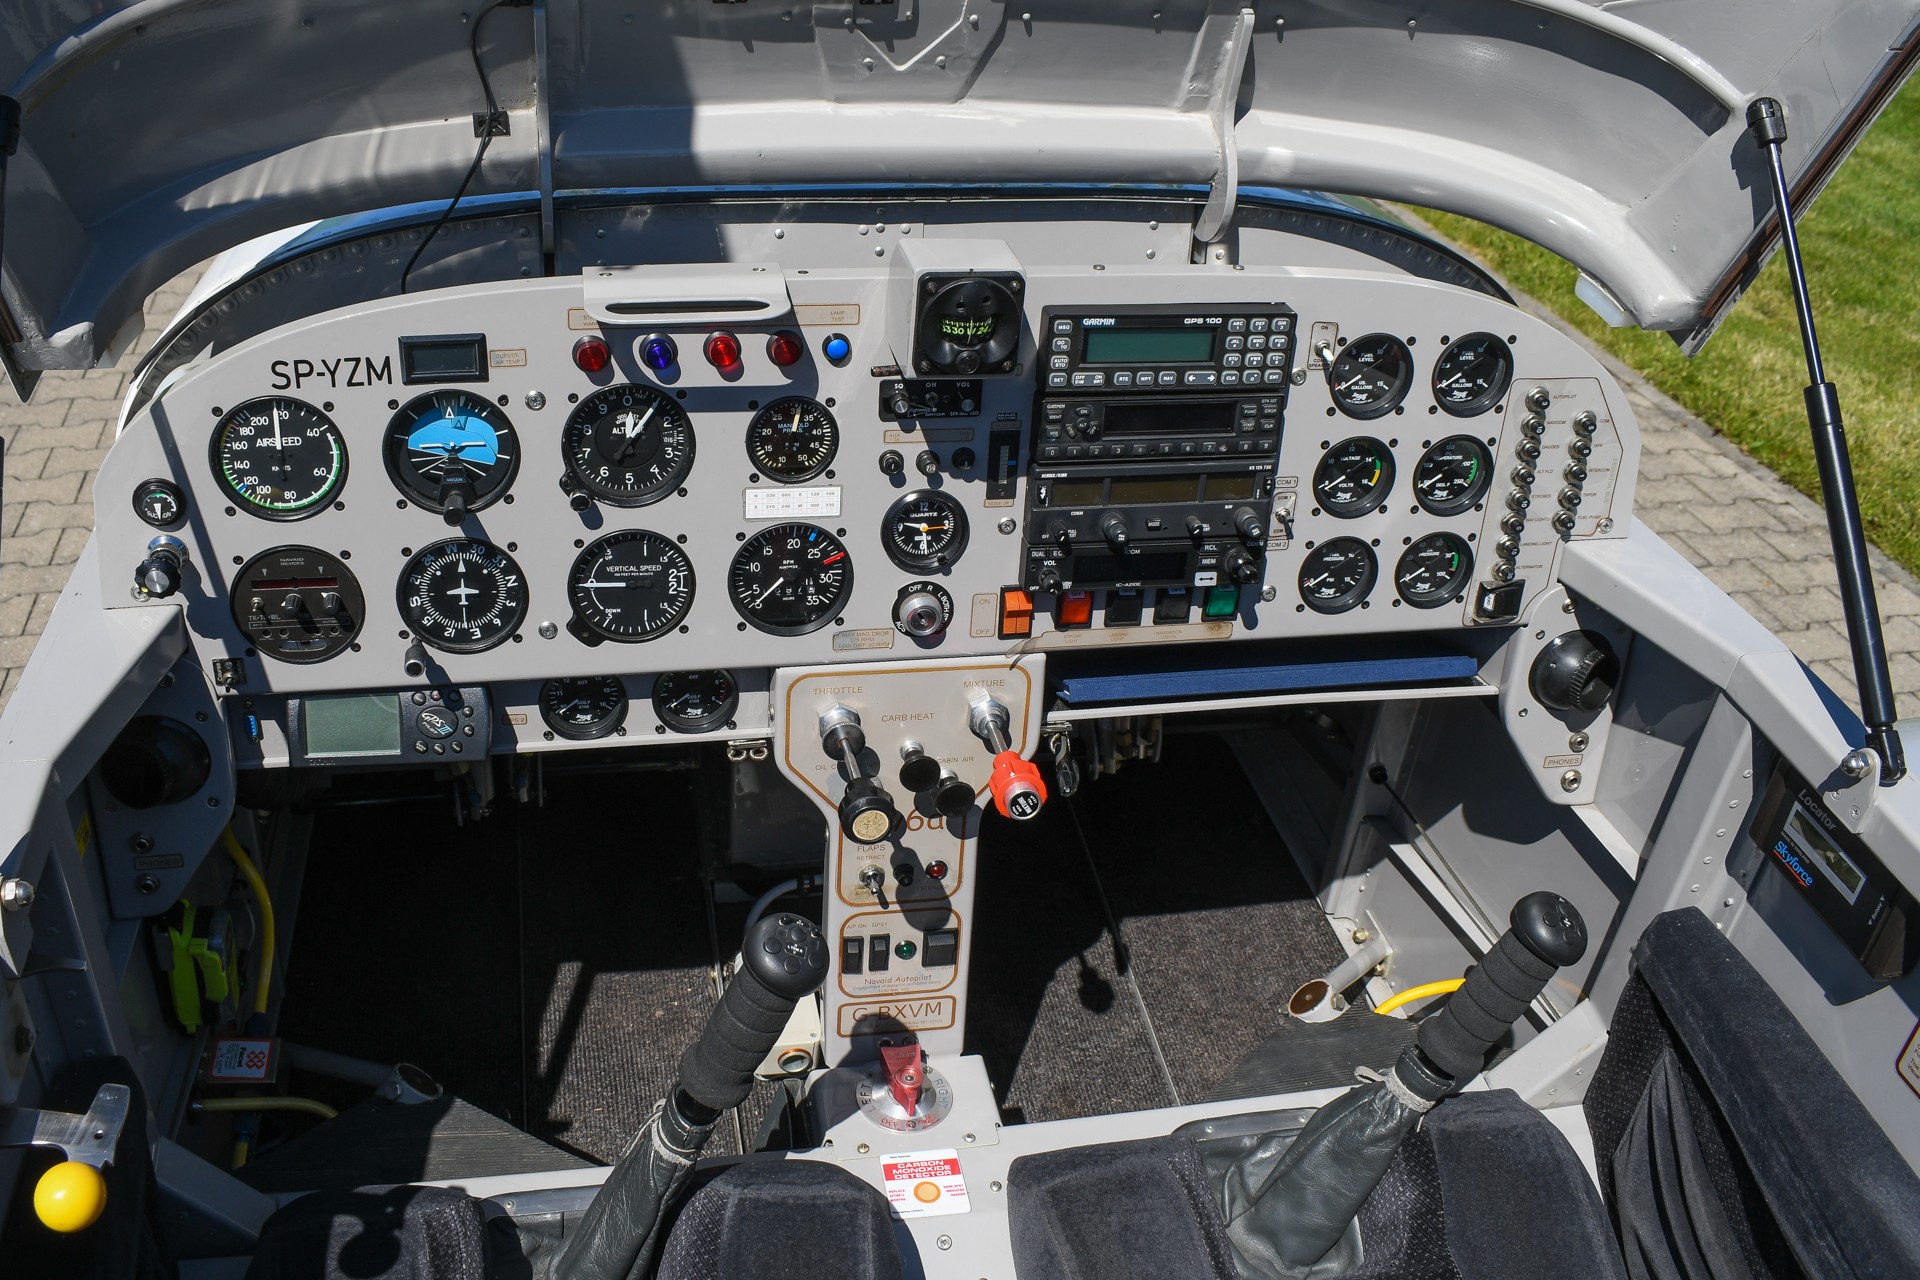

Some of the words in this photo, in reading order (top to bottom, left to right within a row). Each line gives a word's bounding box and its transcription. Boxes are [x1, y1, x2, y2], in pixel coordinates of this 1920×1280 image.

[271, 355, 393, 390] SP-YZM
[250, 417, 268, 425] 200
[240, 427, 254, 436] 180
[307, 429, 319, 437] 40
[232, 441, 248, 450] 160
[256, 437, 302, 447] AIRSEED
[665, 448, 674, 458] 3
[234, 460, 250, 469] 140
[314, 468, 326, 476] 60
[600, 466, 609, 477] 6
[244, 476, 258, 485] 120
[626, 473, 634, 483] 5
[256, 485, 271, 494] 100
[284, 491, 296, 499] 80
[919, 502, 928, 511] 12
[787, 539, 800, 549] 20
[470, 544, 485, 555] 30
[763, 546, 773, 555] 15
[808, 549, 821, 558] 25
[492, 554, 507, 568] 33
[750, 562, 760, 572] 10
[668, 569, 677, 581] 2
[819, 574, 833, 583] 30
[668, 582, 677, 594] 2
[753, 584, 760, 594] 5
[909, 584, 922, 592] OFF
[806, 596, 820, 605] 35
[940, 596, 950, 612] BOTH
[422, 615, 434, 626] 15
[444, 627, 456, 637] 12
[963, 679, 1005, 688] MIXTURE
[813, 686, 864, 695] THROTTLE
[422, 713, 445, 727] GPS
[881, 714, 907, 722] CARB
[910, 712, 935, 721] HEAT
[422, 722, 438, 734] PILOT
[1798, 789, 1838, 830] Locator
[138, 858, 181, 869] PHONES
[1775, 841, 1813, 886] Skyforce
[1871, 902, 1883, 920] Battery
[865, 977, 892, 985] Navaid
[895, 974, 932, 983] Autopilot
[852, 1002, 942, 1022] G-BXVM
[861, 1084, 876, 1113] LEFT
[933, 1079, 948, 1108] RIGHT
[881, 1118, 898, 1127] OFF
[892, 1165, 951, 1174] MONOXIDE
[894, 1171, 952, 1180] DETECTOR
